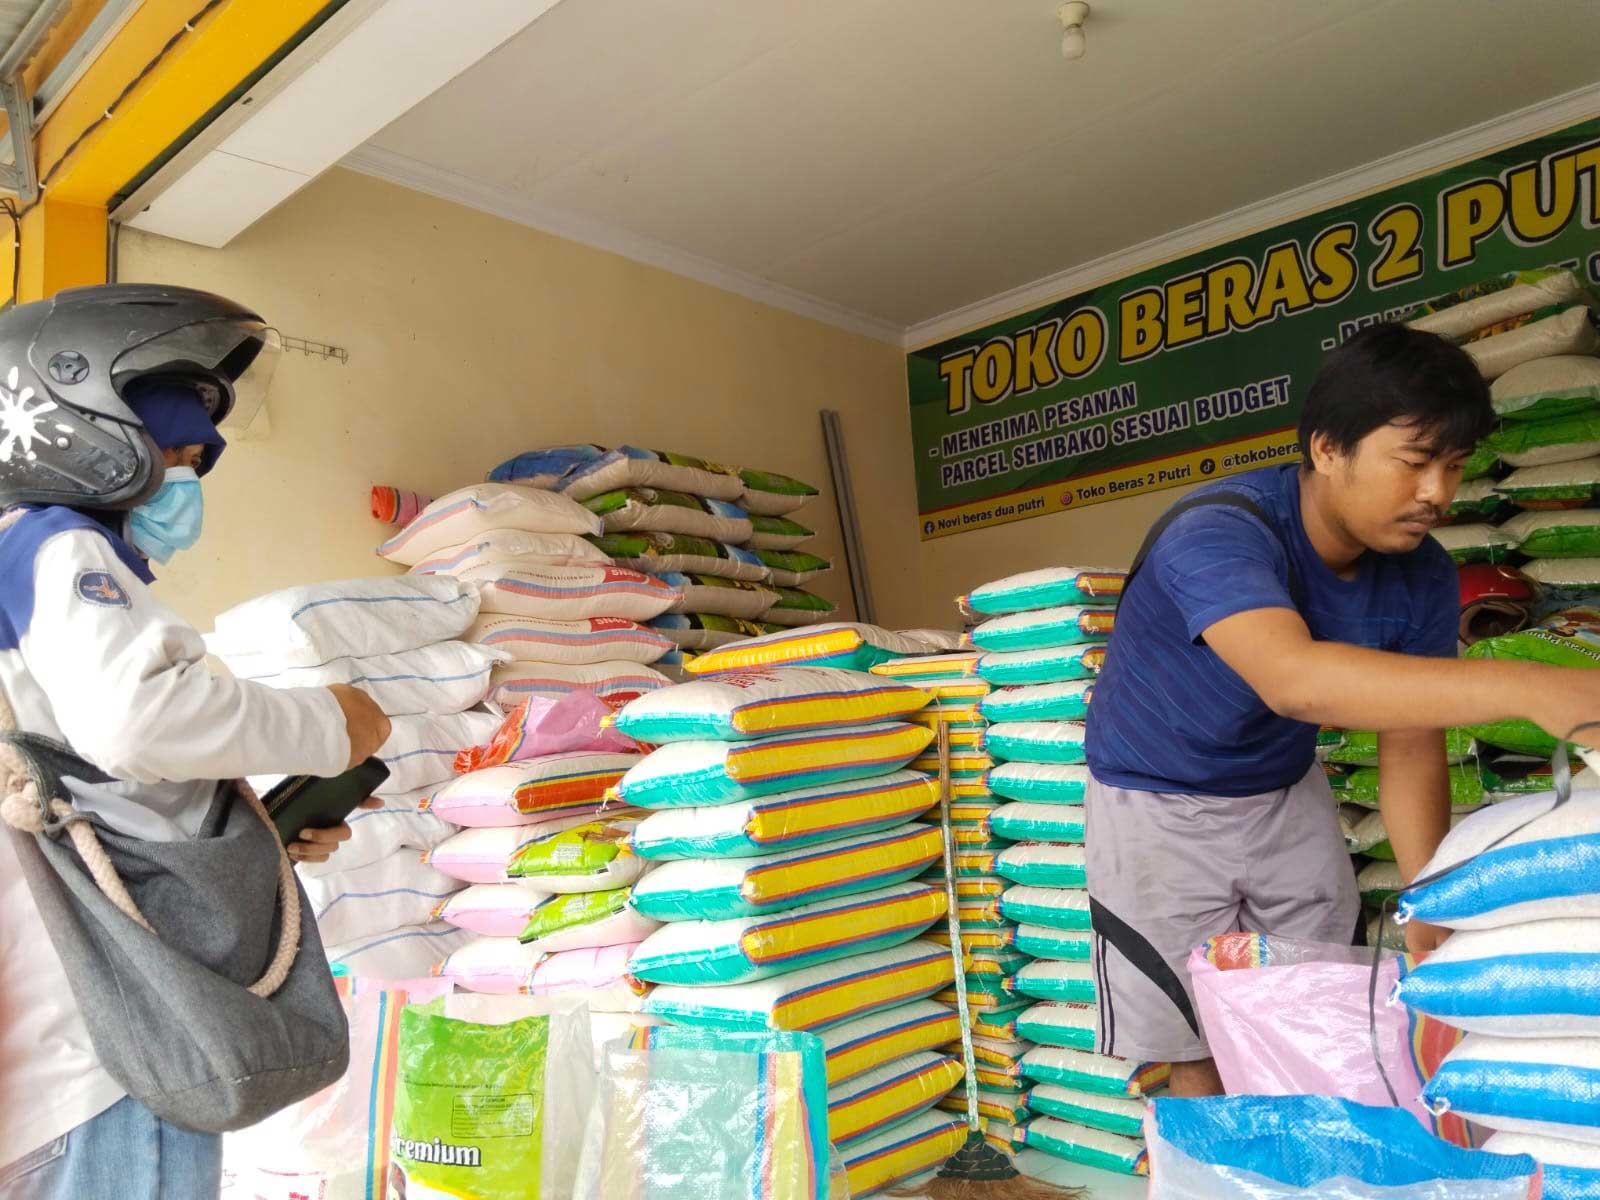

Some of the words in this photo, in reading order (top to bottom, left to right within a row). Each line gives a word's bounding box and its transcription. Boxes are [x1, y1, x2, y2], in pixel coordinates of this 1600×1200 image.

[940, 306, 1107, 414] TOKO
[1118, 222, 1358, 364] BERAS
[1368, 202, 1424, 292] 2
[941, 451, 1008, 488] PARCEL
[1012, 423, 1108, 471] SEMBAKO
[1111, 401, 1190, 446] SESUAI
[1194, 374, 1291, 425] BUDGET
[942, 410, 1040, 458] MENERIMA
[1043, 382, 1137, 429] PESANAN
[1077, 484, 1105, 500] Toko
[1108, 477, 1143, 494] Beras
[1147, 473, 1155, 485] 2
[1159, 464, 1191, 482] Putri
[1222, 442, 1299, 469] @tokobera
[938, 515, 960, 530] Novi
[963, 509, 992, 524] beras
[995, 504, 1015, 518] dua
[1018, 496, 1045, 513] putri
